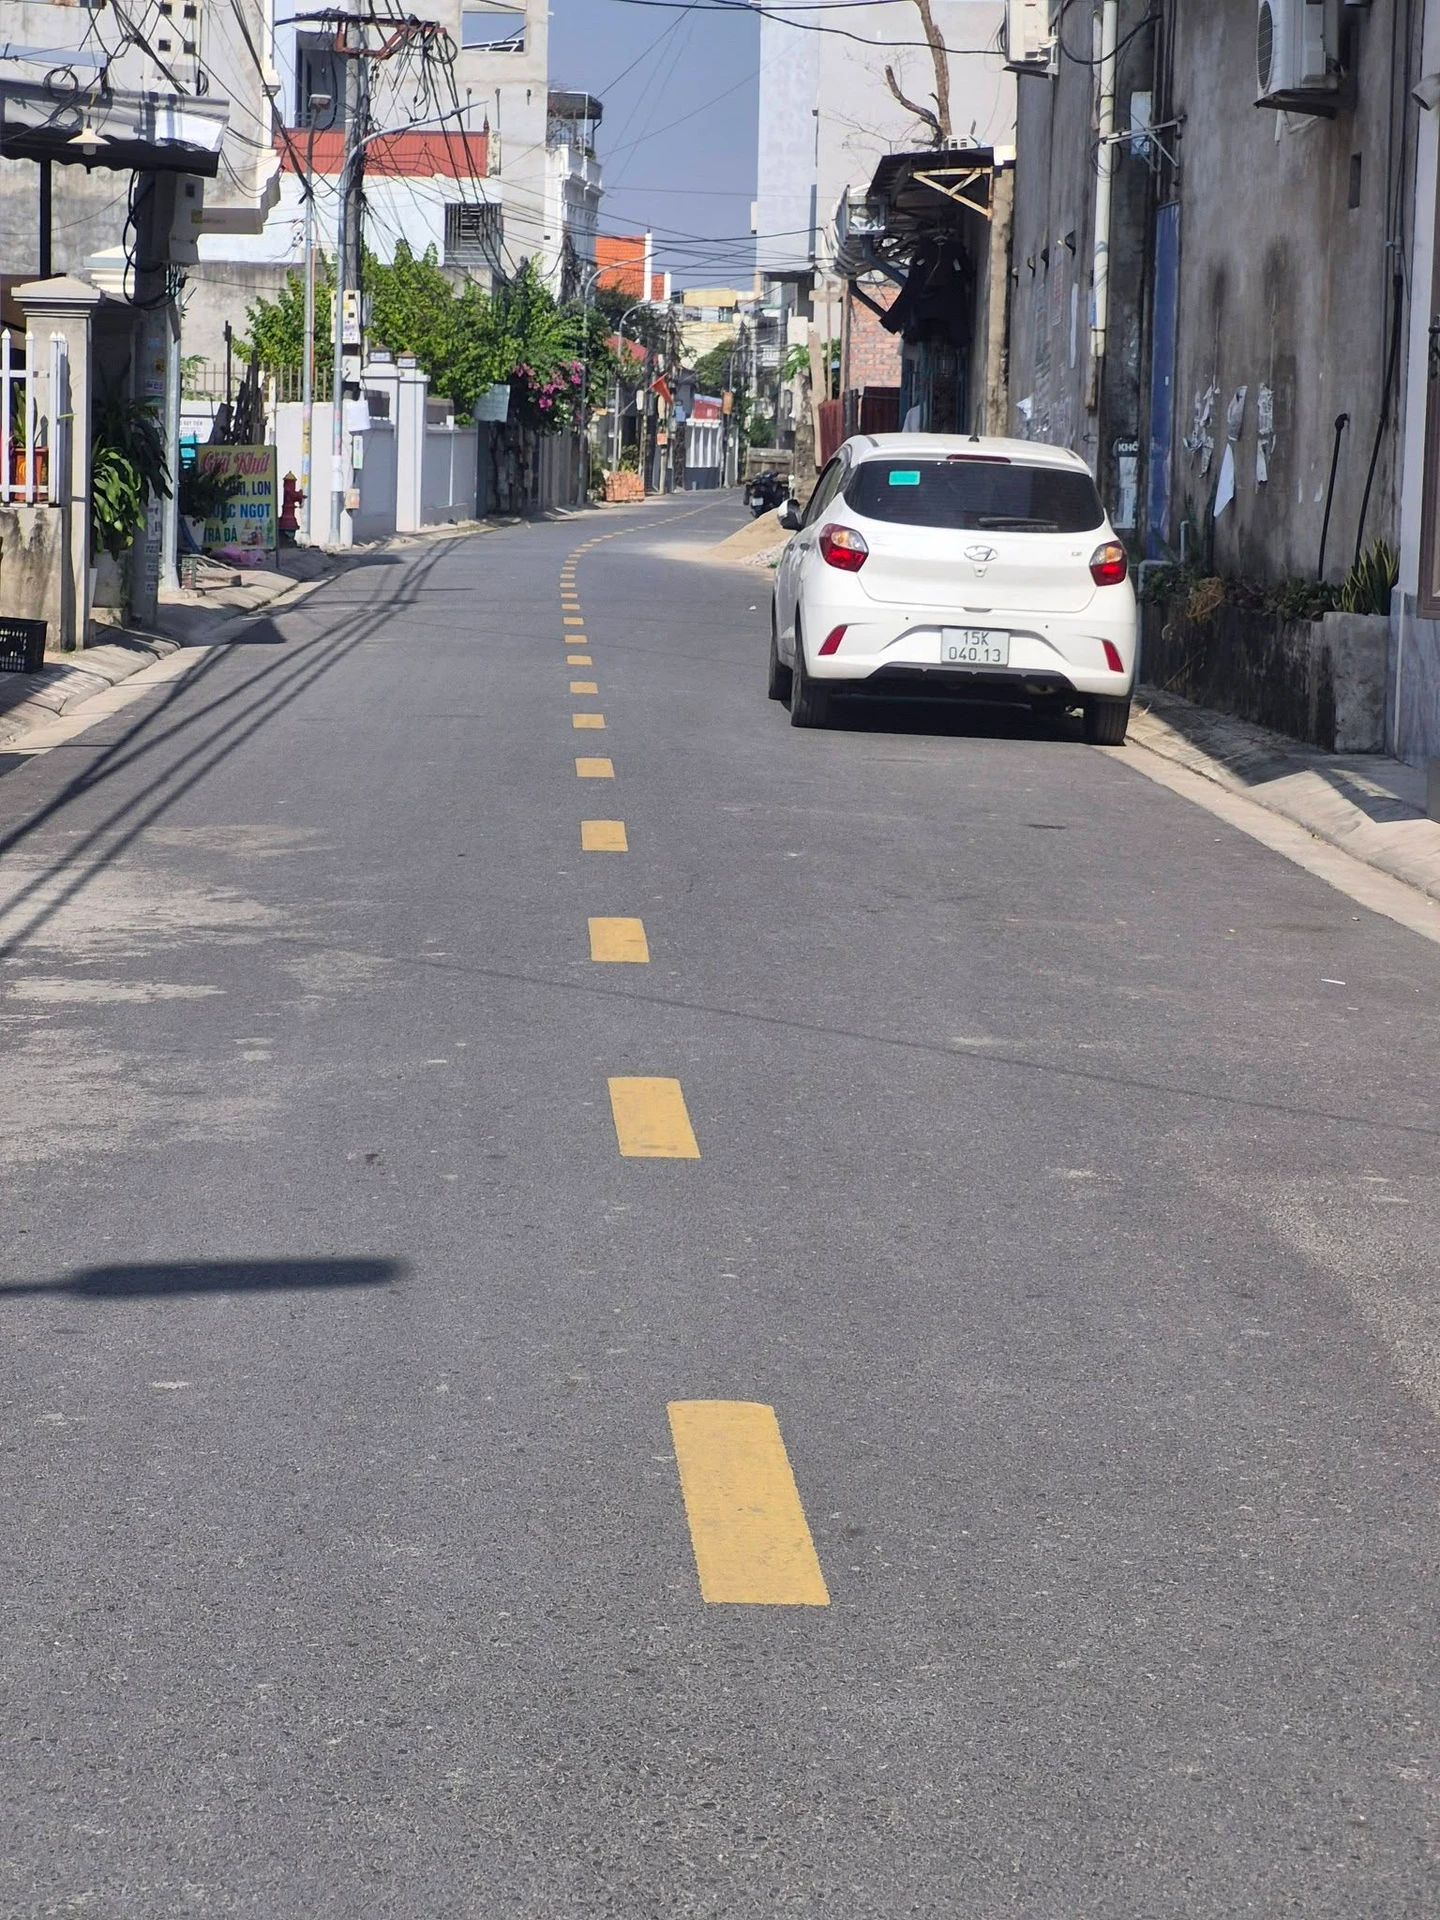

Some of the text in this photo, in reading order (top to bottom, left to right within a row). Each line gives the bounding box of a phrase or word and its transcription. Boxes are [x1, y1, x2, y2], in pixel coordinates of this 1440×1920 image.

[252, 481, 271, 495] LON
[240, 503, 271, 522] NGỌT
[963, 631, 990, 646] 15K
[948, 646, 1001, 663] 040.13
